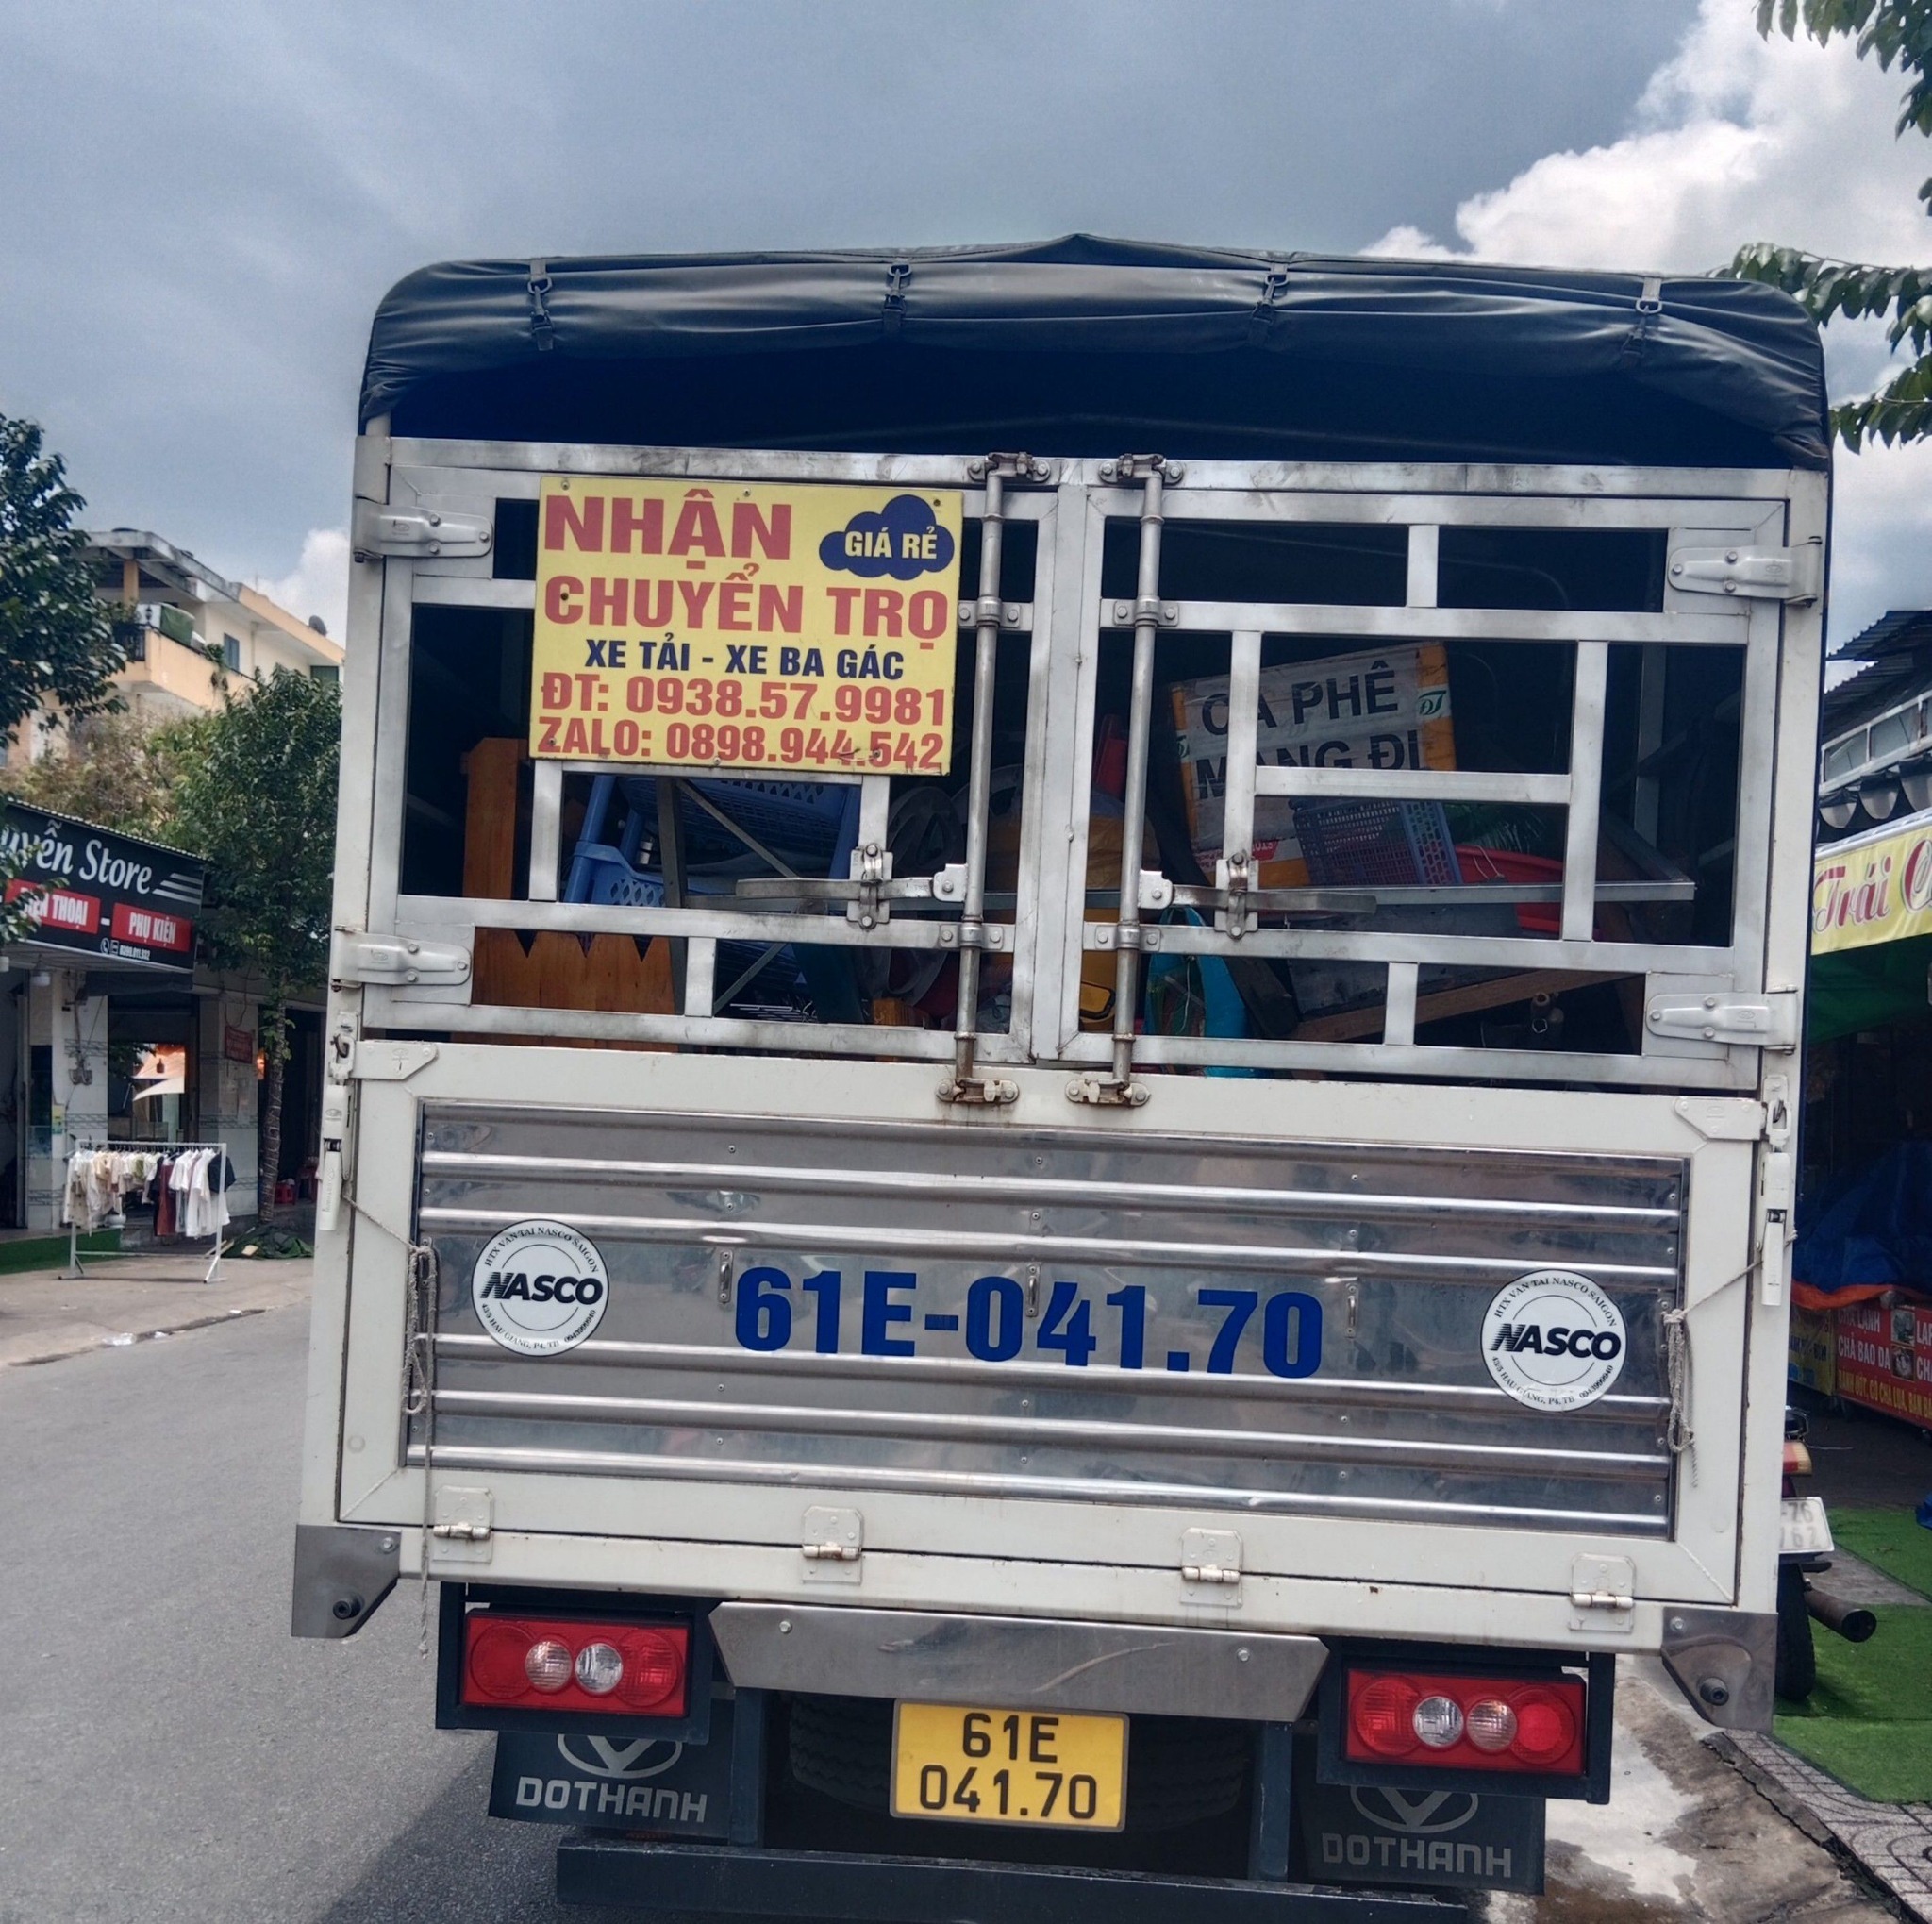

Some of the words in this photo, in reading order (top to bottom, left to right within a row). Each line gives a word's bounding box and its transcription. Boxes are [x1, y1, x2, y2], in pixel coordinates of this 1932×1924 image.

[544, 488, 792, 570] NHẬN
[844, 524, 892, 559] GIÁ
[901, 525, 938, 560] RẺ
[544, 562, 804, 634] CHUYỂN
[826, 586, 949, 650] TRỌ
[585, 639, 627, 668] XE
[639, 632, 691, 671] TẢI
[725, 644, 768, 675] XE
[780, 647, 824, 677] BA
[836, 644, 905, 679] GÁC
[541, 672, 609, 711] ĐT:
[625, 677, 945, 727] 0938.57.9981
[1291, 660, 1398, 725] PHÊ
[537, 716, 652, 757] ZALO:
[666, 723, 943, 769] 0898.944.542
[78, 839, 153, 895] Store
[52, 894, 89, 929] THOẠI
[128, 912, 152, 943] PHỤ
[152, 916, 176, 946] KIỆN
[484, 1246, 501, 1267] HTX
[538, 1227, 572, 1241] NASCO
[572, 1238, 599, 1273] SAIGON
[479, 1271, 603, 1305] NASCO
[1494, 1297, 1511, 1318] HTX
[1552, 1277, 1588, 1293] NASCO
[1588, 1290, 1617, 1327] SAIGON
[735, 1265, 1323, 1379] 61E-041.70
[1490, 1323, 1621, 1361] NASCO
[1838, 1332, 1857, 1360] CHẢ
[1857, 1340, 1875, 1365] BAO
[1878, 1347, 1891, 1370] DA
[962, 1712, 1059, 1764] 61E
[515, 1776, 708, 1823] DOTHANH
[919, 1765, 1097, 1819] 041.70
[1321, 1832, 1511, 1878] DOTHANH
